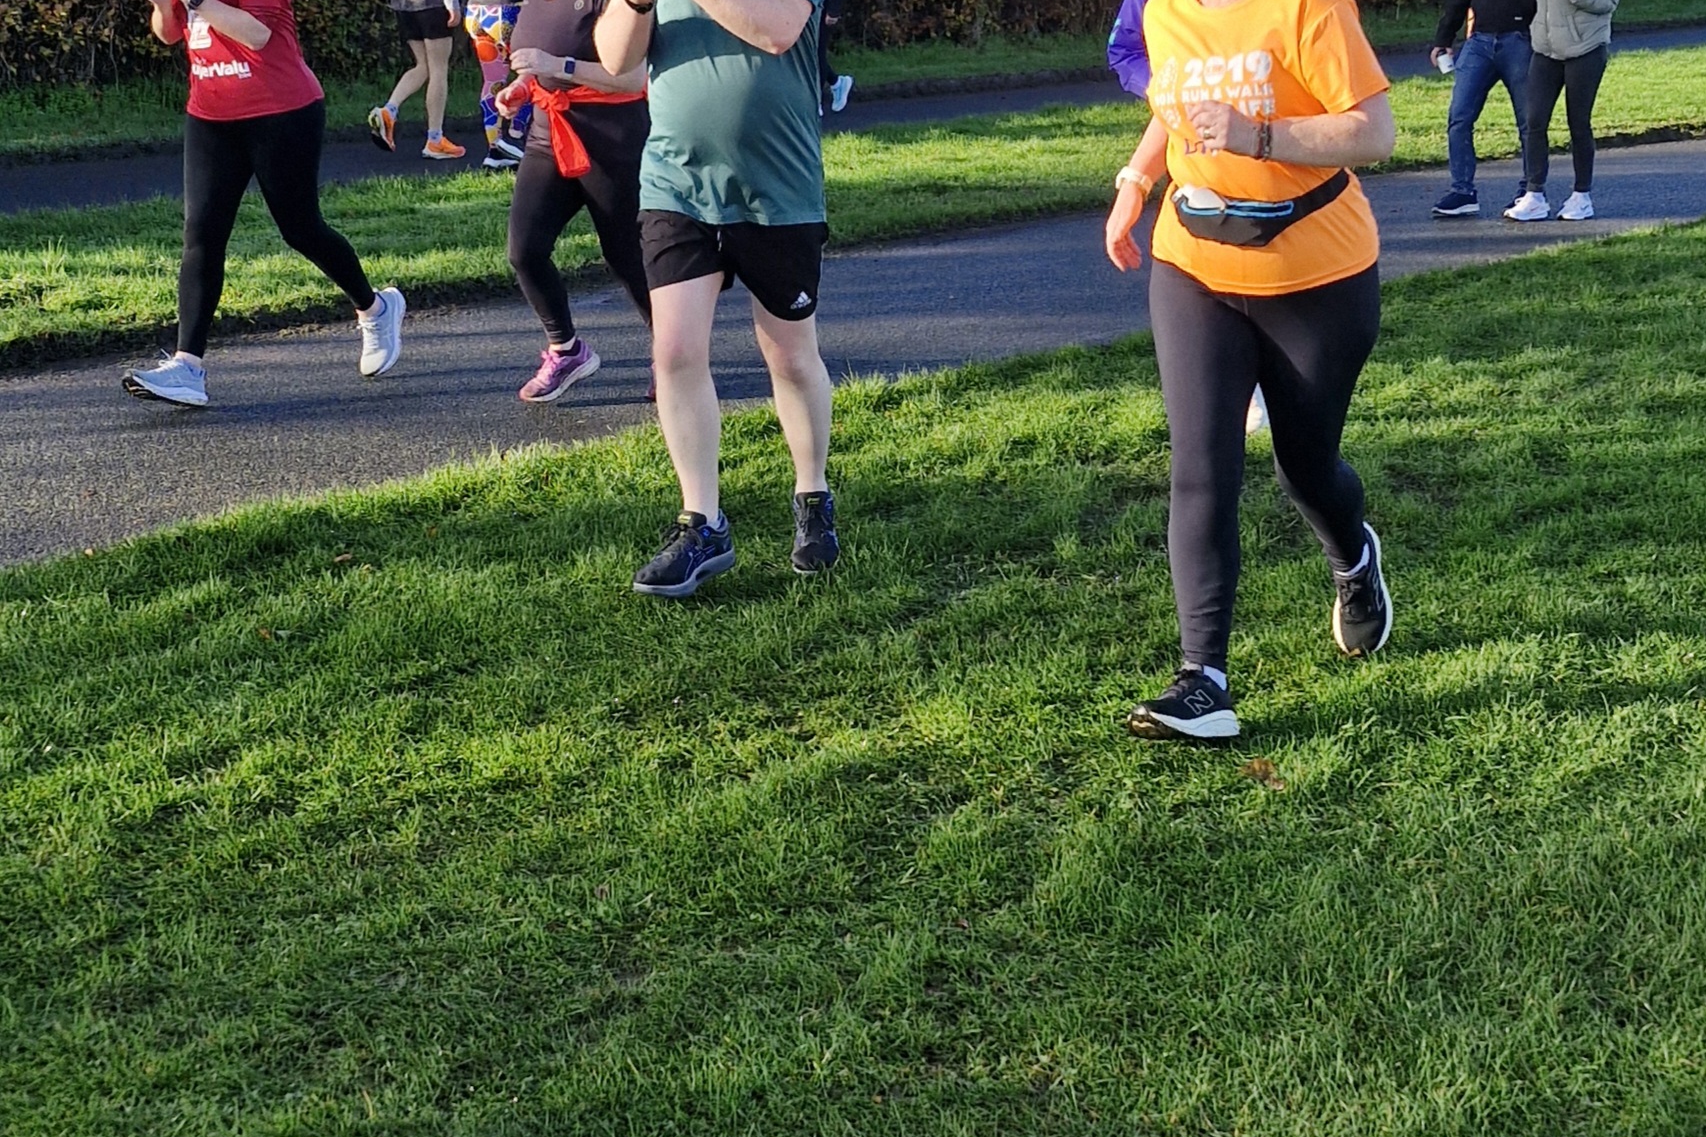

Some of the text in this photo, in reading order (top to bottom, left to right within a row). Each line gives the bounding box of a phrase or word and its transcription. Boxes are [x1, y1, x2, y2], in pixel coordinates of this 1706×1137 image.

[192, 60, 250, 80] uperValu
[1182, 50, 1273, 88] 2019
[1181, 88, 1209, 103] RUN
[1212, 86, 1222, 100] &
[1225, 82, 1274, 99] WALK
[1225, 98, 1275, 117] IFE
